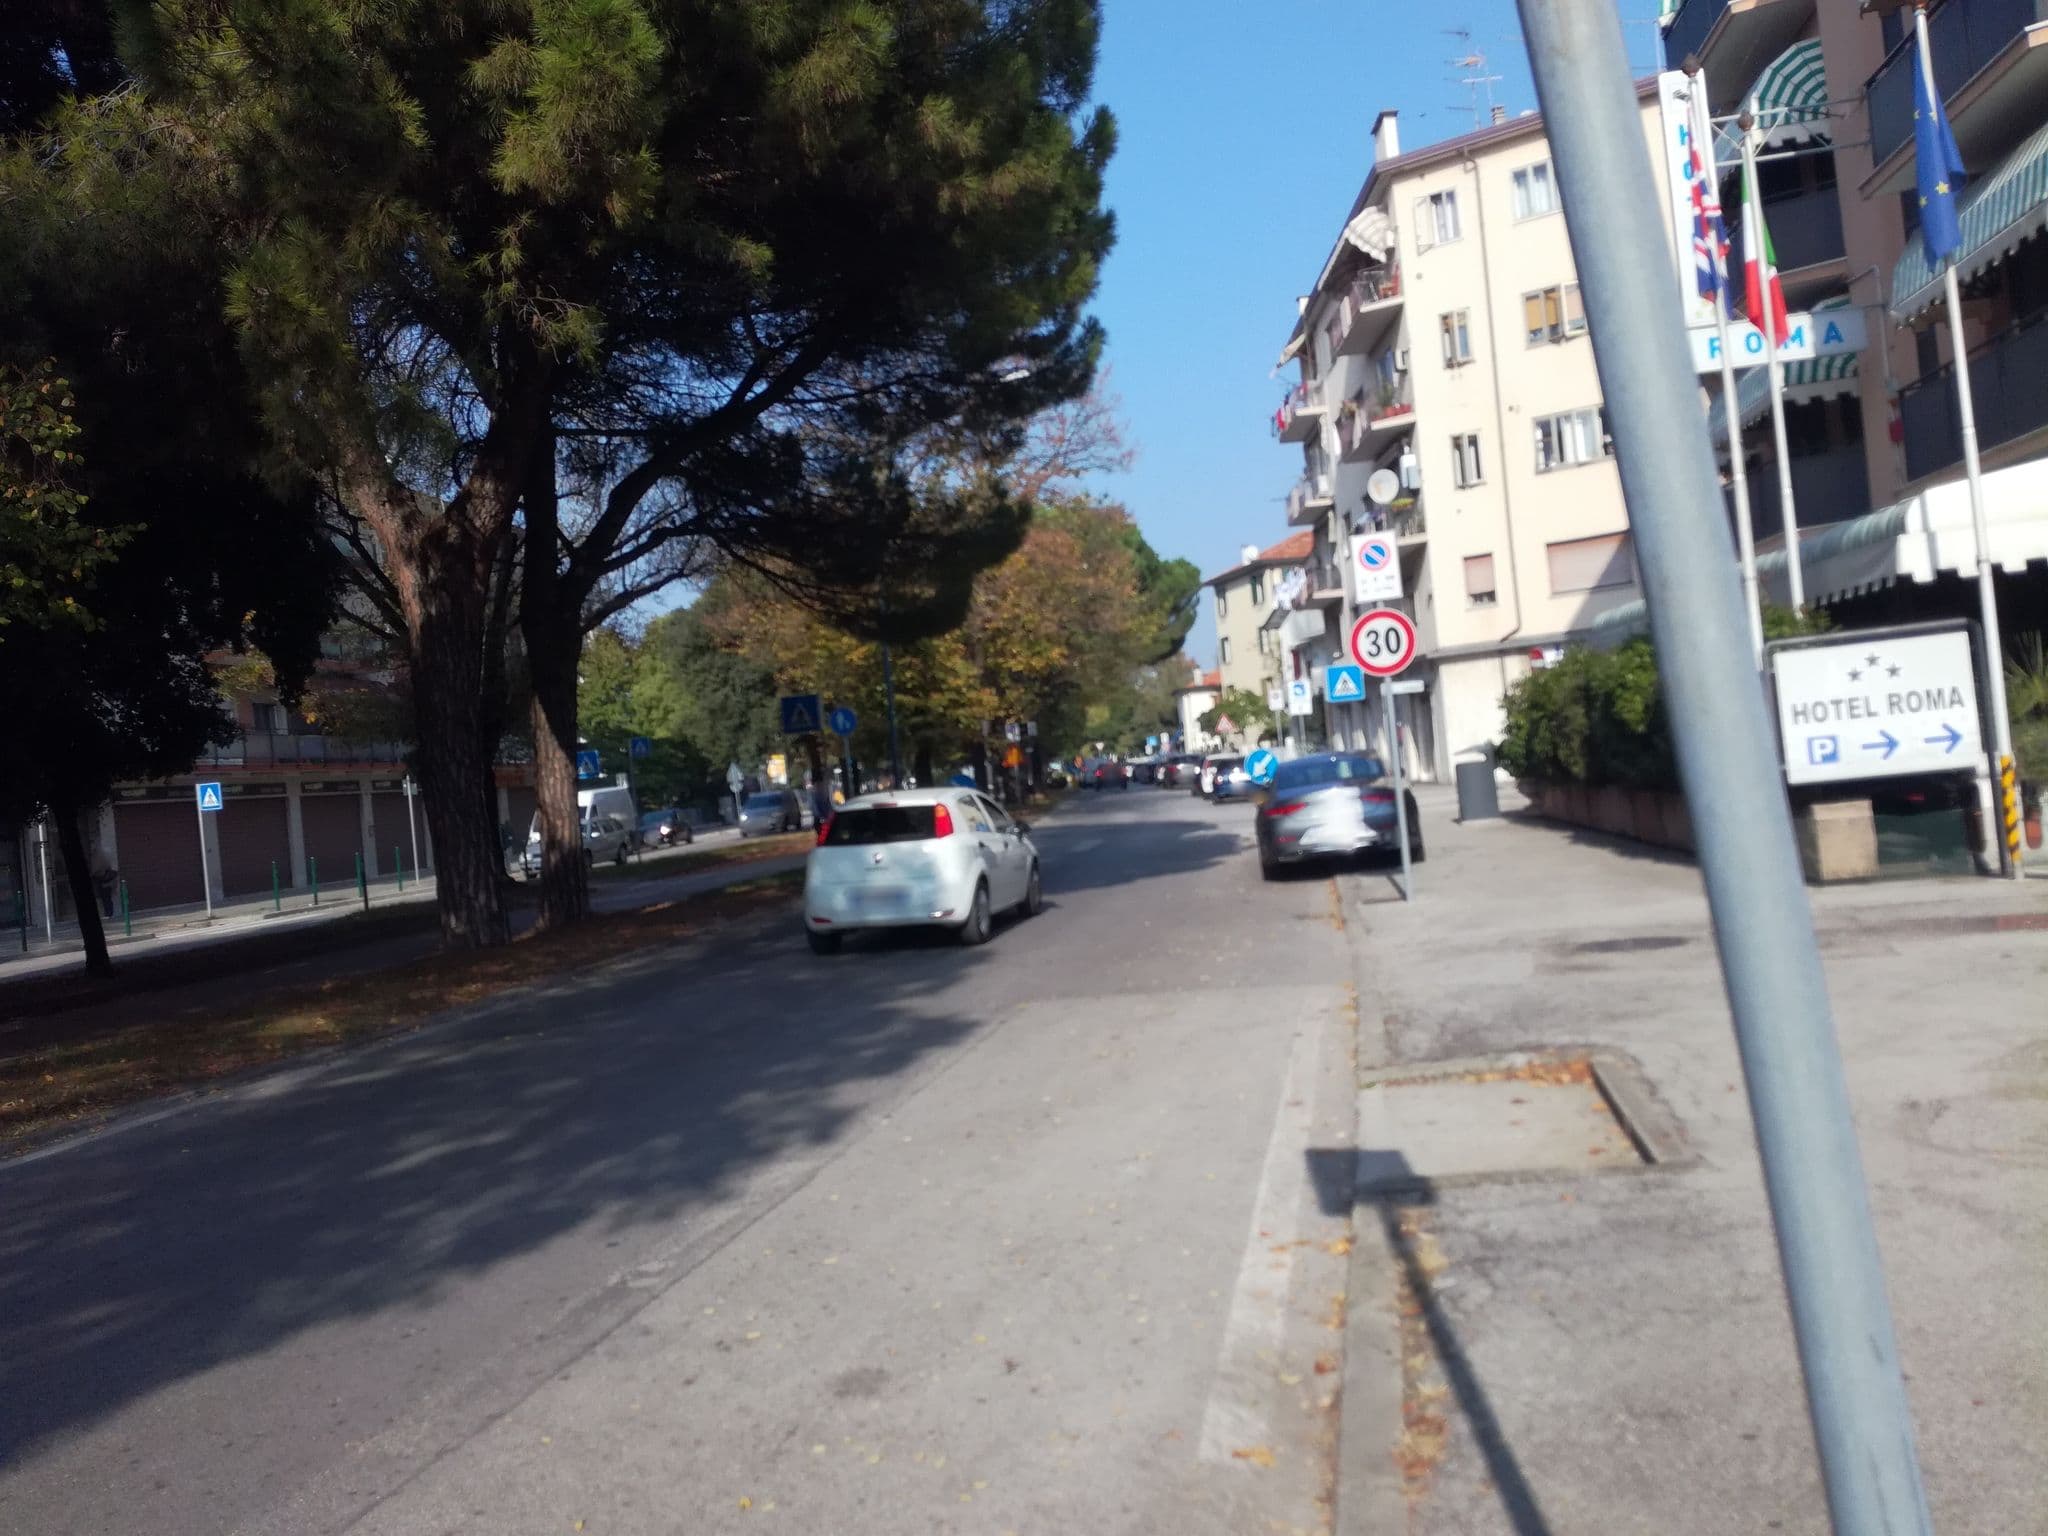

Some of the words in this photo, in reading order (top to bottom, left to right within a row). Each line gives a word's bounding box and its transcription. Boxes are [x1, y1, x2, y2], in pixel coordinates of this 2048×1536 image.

[1366, 626, 1401, 657] 30
[1791, 695, 1879, 725] HOTEL
[1886, 685, 1966, 716] ROMA
[1811, 738, 1836, 763] P
